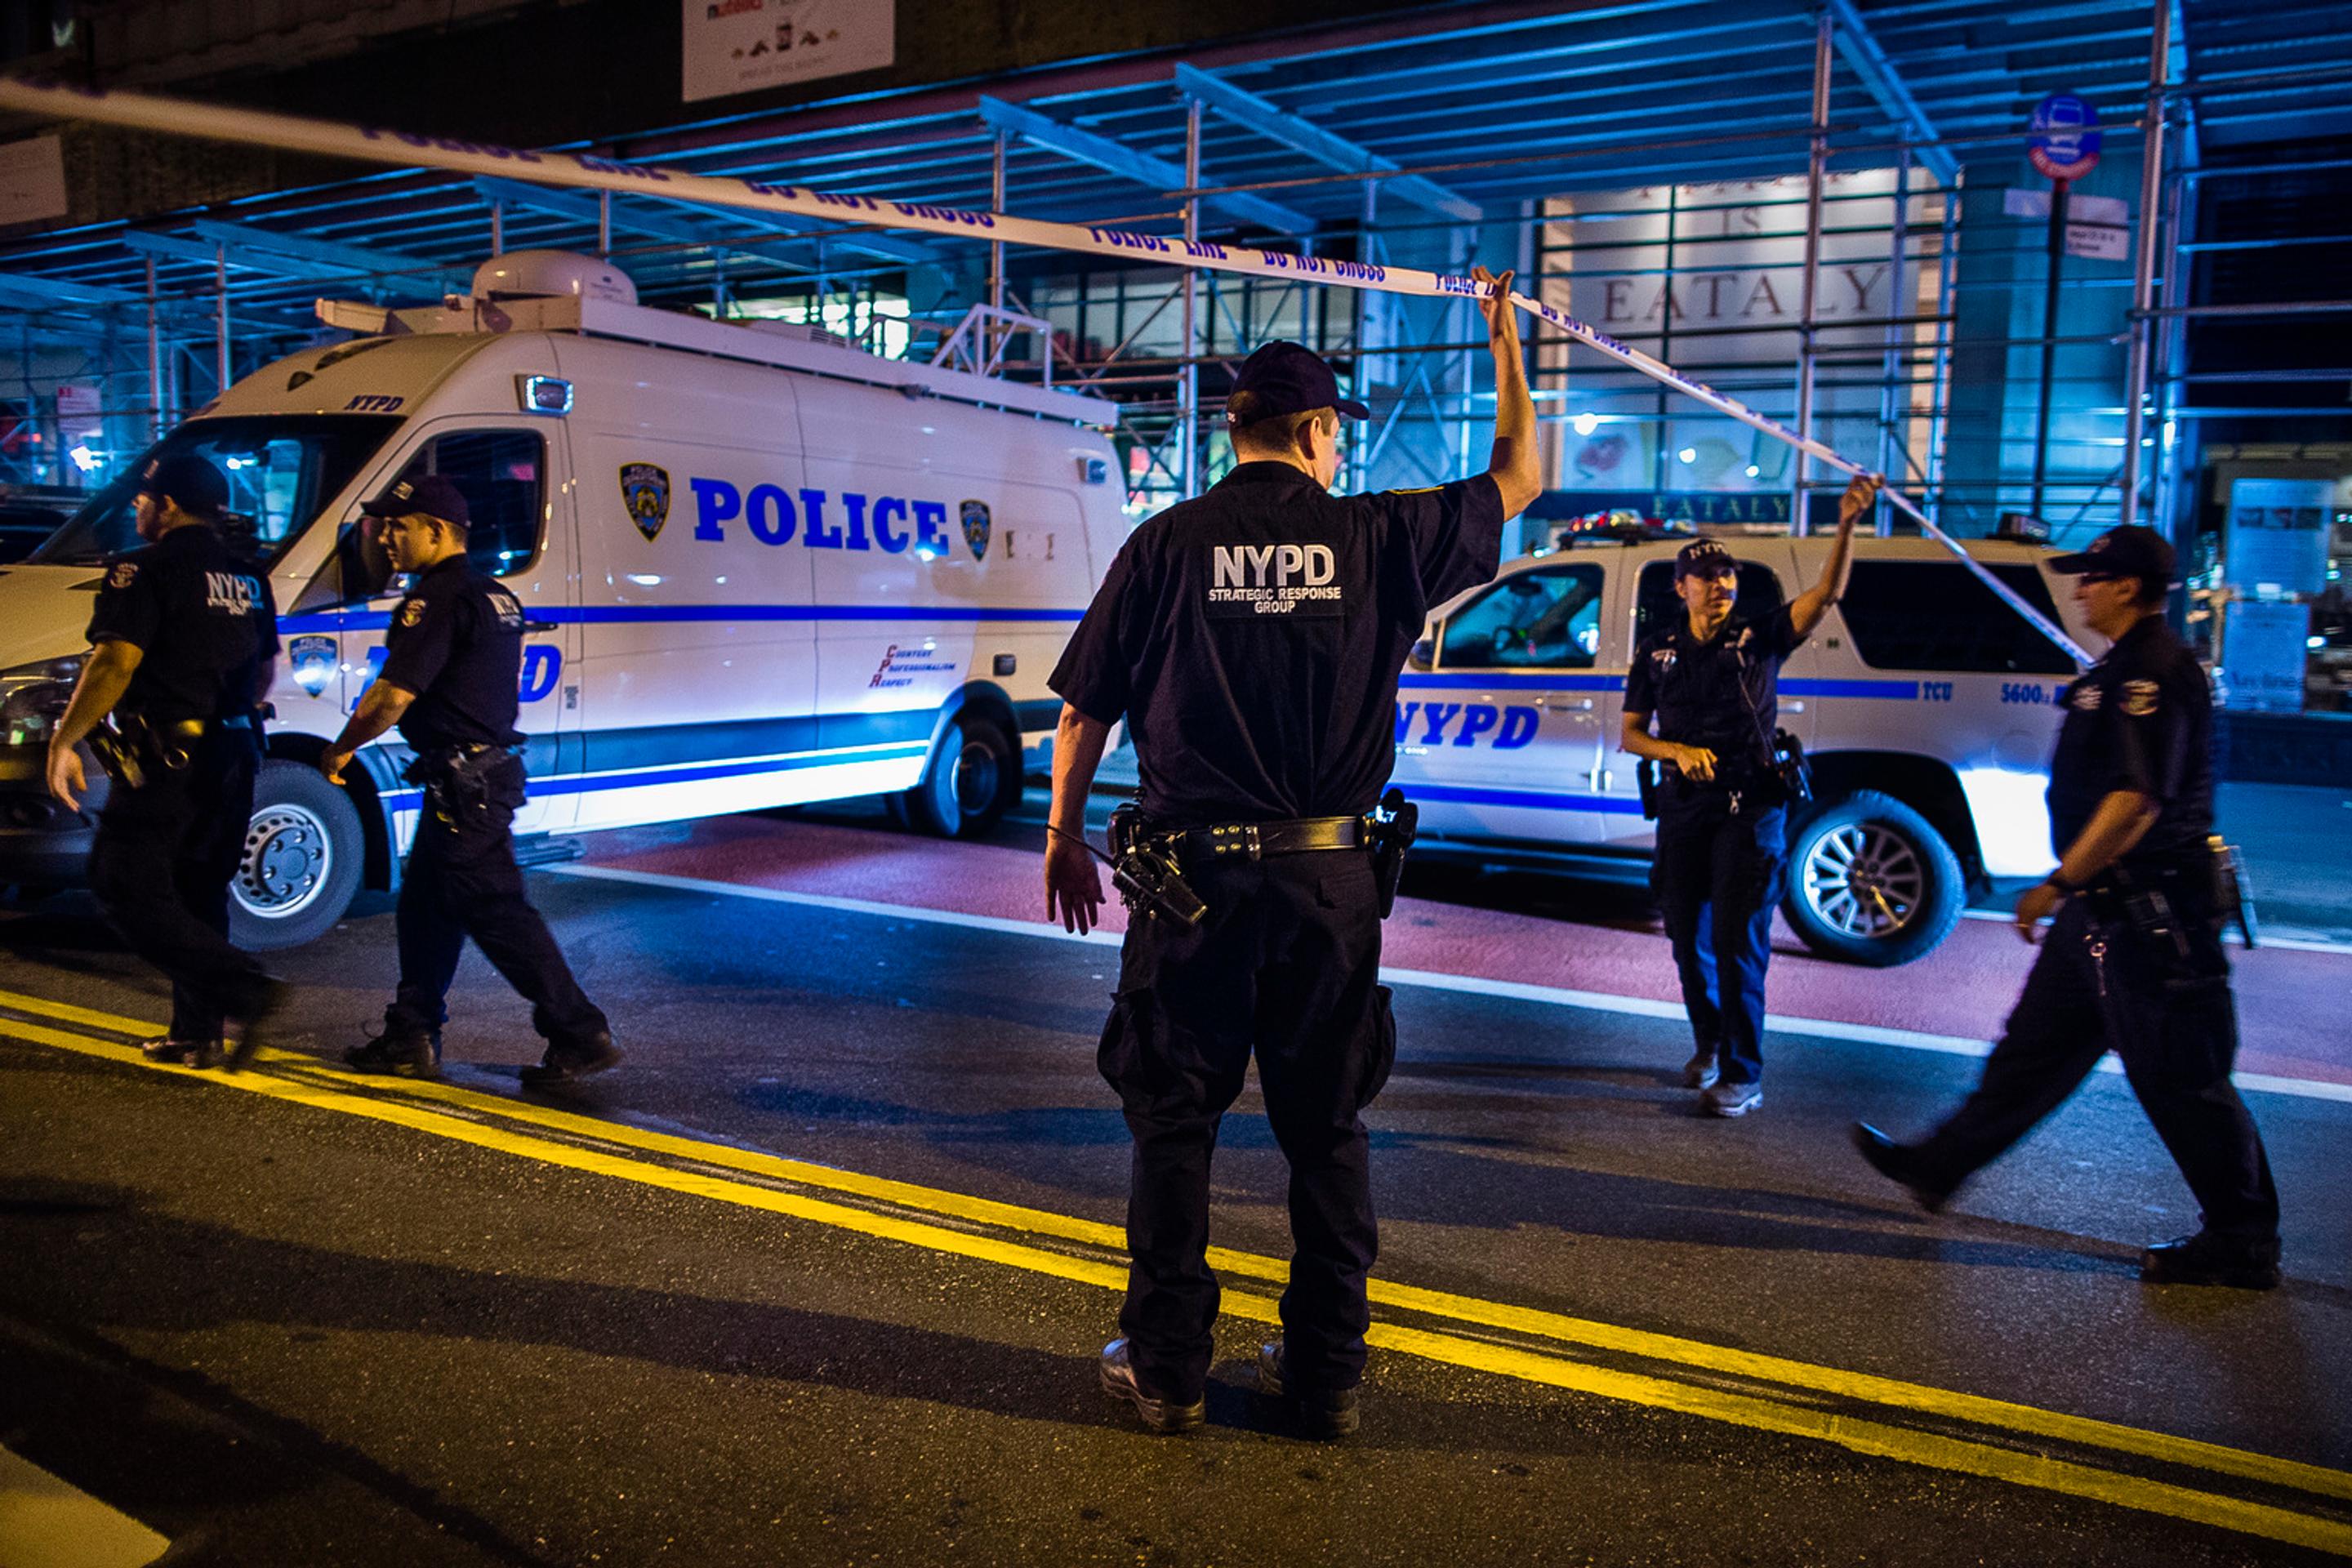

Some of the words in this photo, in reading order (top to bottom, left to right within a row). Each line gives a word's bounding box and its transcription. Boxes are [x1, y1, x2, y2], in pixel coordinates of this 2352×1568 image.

[344, 395, 404, 412] NYPD
[690, 477, 949, 555] POLICE
[1653, 494, 1788, 519] EATALY
[1214, 544, 1335, 587] NYPD
[205, 571, 261, 600] NYPD
[1209, 588, 1274, 601] STRATEGIC
[1278, 586, 1342, 600] RESPONSE
[1254, 600, 1296, 613] GROUP
[1923, 682, 1953, 701] TCU
[1395, 702, 1539, 750] NYPD
